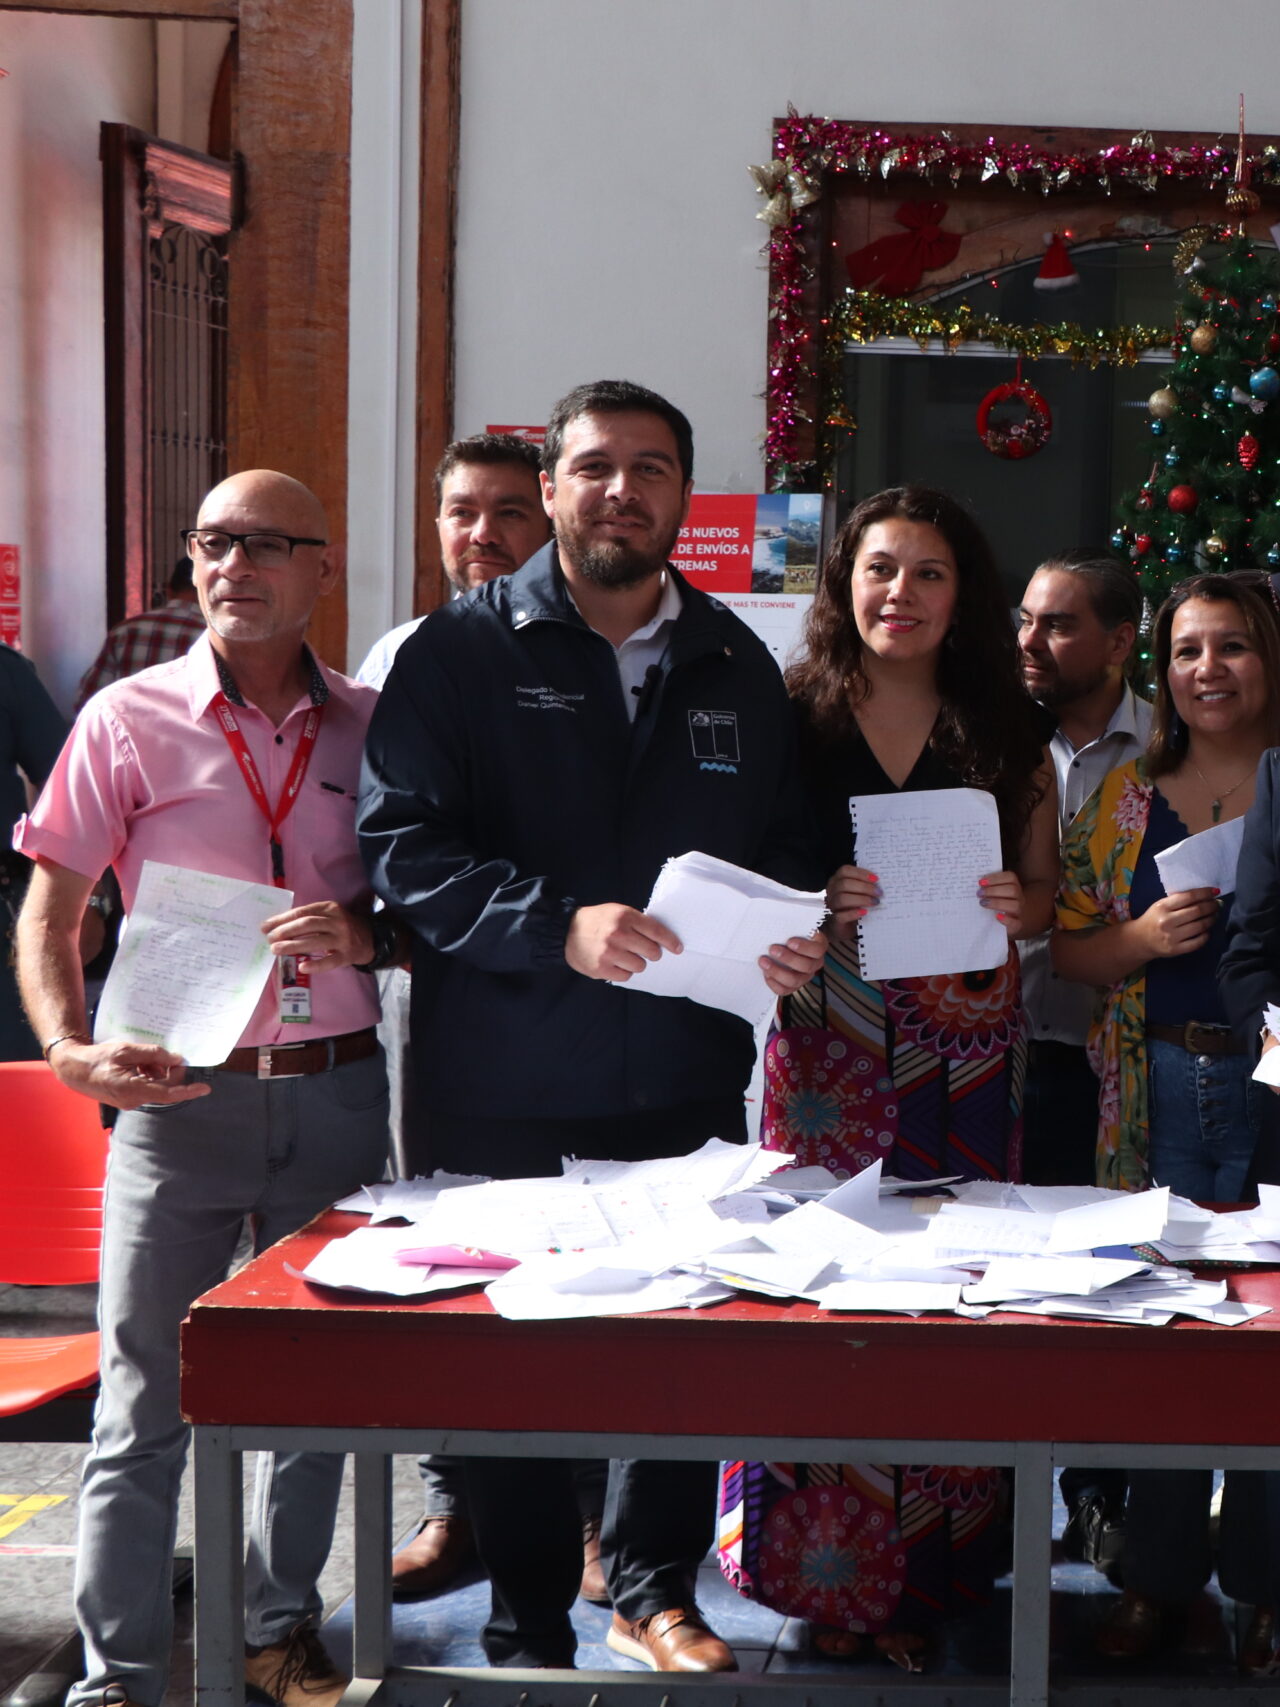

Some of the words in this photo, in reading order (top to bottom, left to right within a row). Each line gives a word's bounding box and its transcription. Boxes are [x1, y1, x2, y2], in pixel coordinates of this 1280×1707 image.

[692, 527, 740, 539] NUEVOS
[678, 543, 694, 555] DE
[696, 541, 739, 555] ENVÍOS
[741, 544, 751, 555] A
[734, 601, 749, 609] MAS
[750, 601, 760, 609] TE
[760, 601, 796, 609] CONVIENE
[516, 686, 548, 695] Delegado
